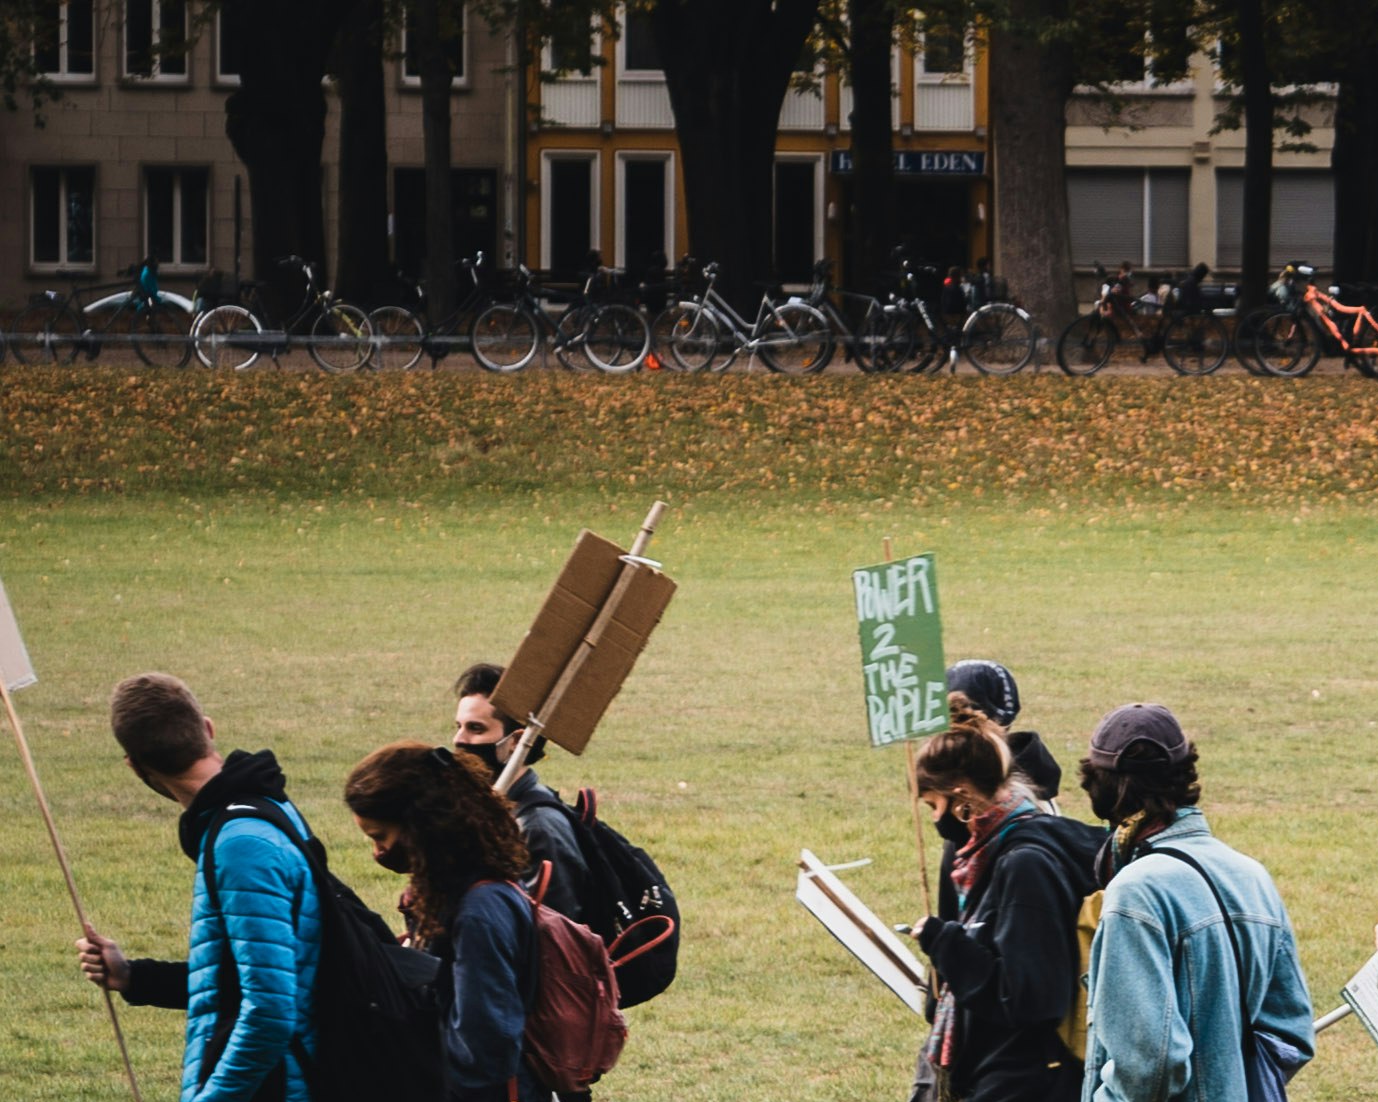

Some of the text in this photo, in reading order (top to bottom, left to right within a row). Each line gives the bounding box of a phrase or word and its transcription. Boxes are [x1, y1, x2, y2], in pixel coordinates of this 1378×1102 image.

[921, 153, 977, 171] EDEN
[853, 557, 935, 622] POWER
[869, 623, 900, 661] 2
[864, 653, 919, 694] THE
